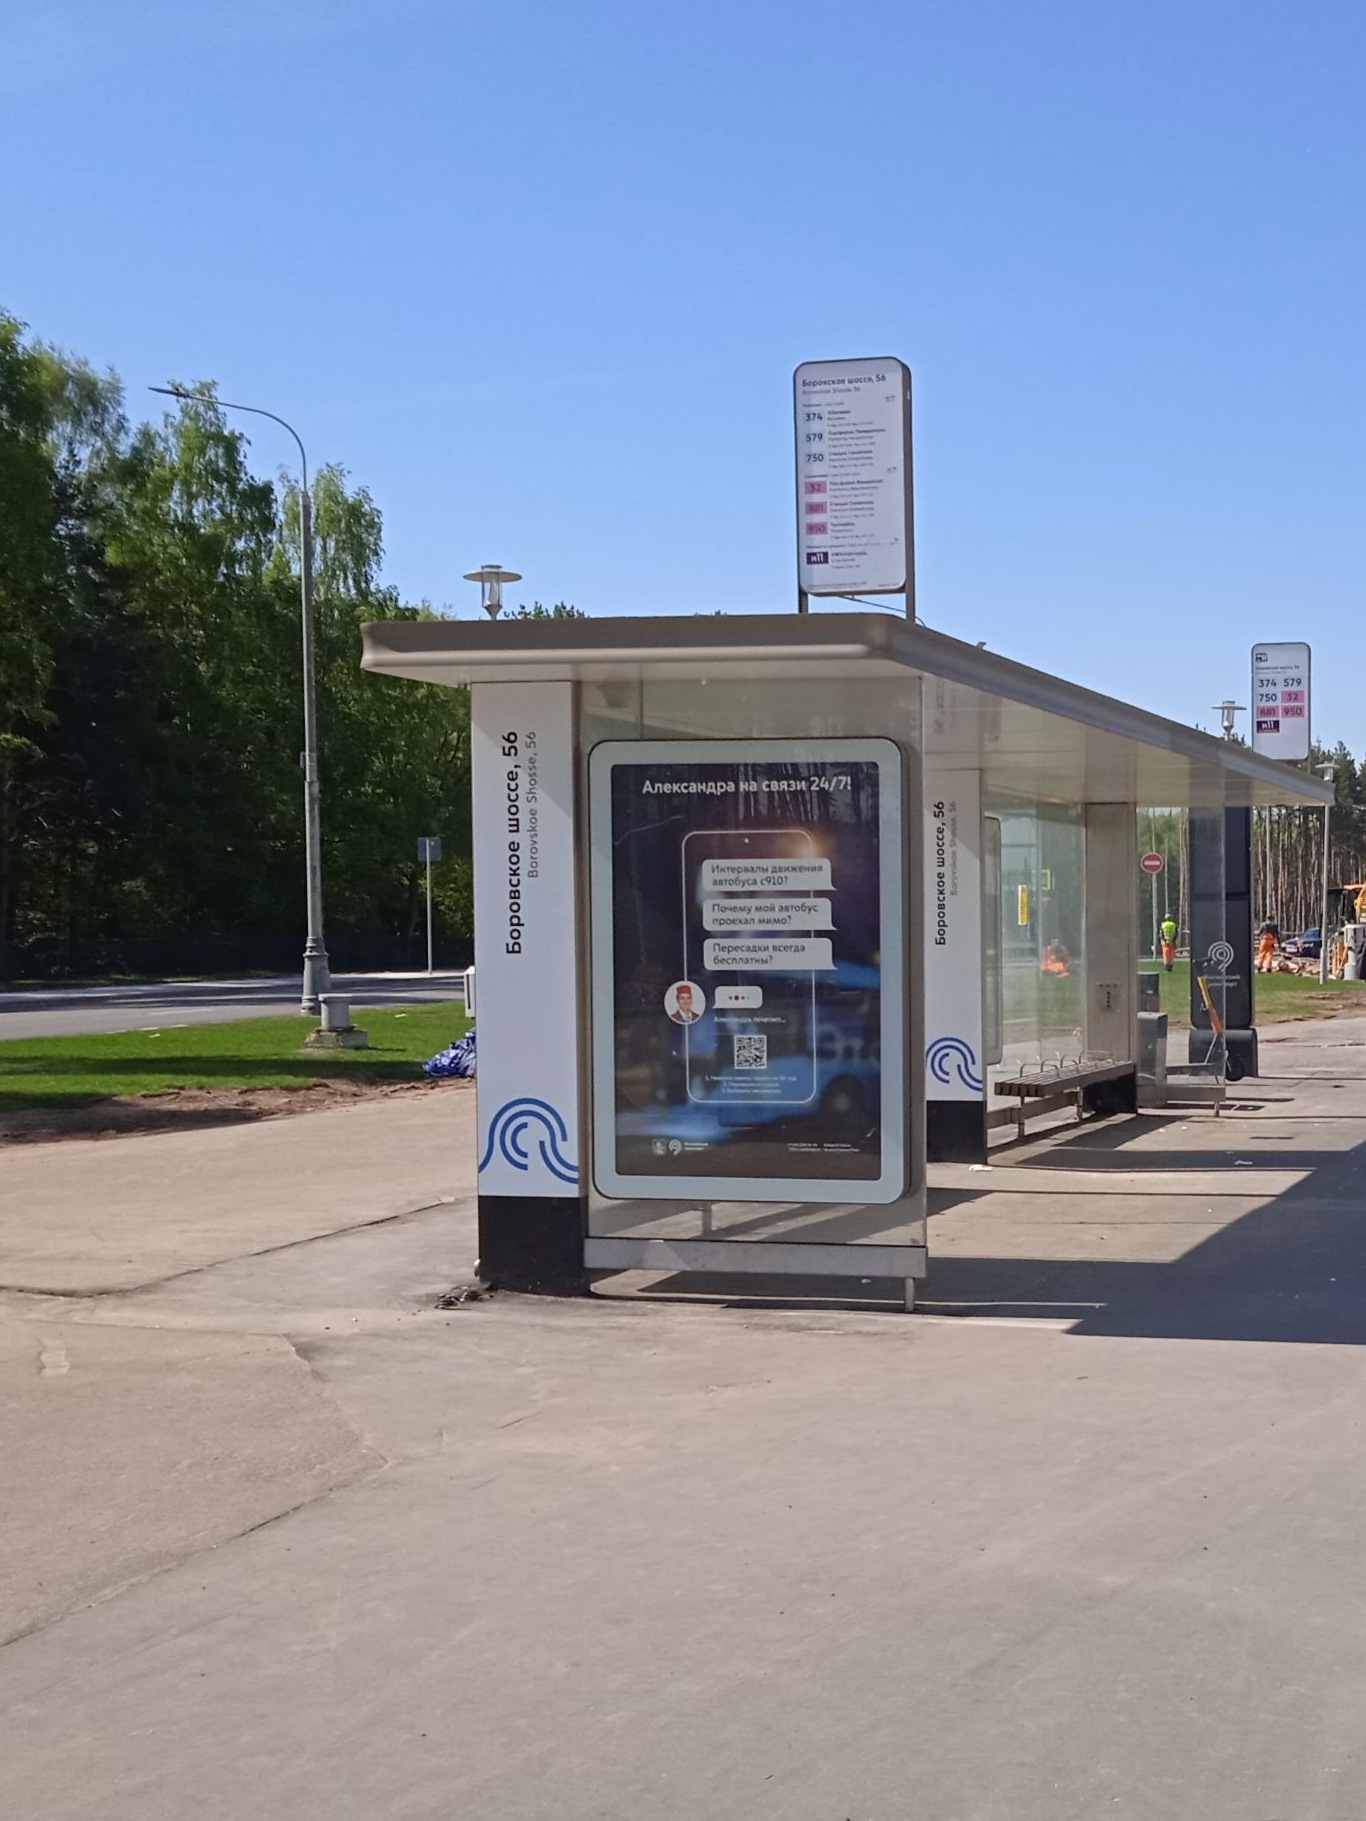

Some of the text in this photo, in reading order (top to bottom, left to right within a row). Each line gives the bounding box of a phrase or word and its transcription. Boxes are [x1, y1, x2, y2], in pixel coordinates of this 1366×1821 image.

[802, 374, 886, 388] Боровское шоссе, 56
[805, 412, 823, 422] 374
[806, 432, 823, 442] 579
[807, 453, 824, 462] 750
[1259, 678, 1302, 688] 374 579
[1259, 692, 1299, 702] 750 32
[1260, 707, 1302, 716] 881 950
[642, 776, 852, 796] Александра на связи 24/7!
[525, 731, 539, 878] Borovskoe Shosse, 56
[502, 731, 524, 954] Боровское шоссе, 56
[711, 865, 824, 875] Интервалы движения
[933, 801, 949, 945] Боровское шоссе, 56
[712, 875, 789, 888] автобуса с910?
[712, 902, 819, 914] Почему мой автобус
[712, 915, 792, 926] проехал мимо?
[713, 942, 806, 954] Пересадки всегда
[713, 954, 773, 965] бесплатны?
